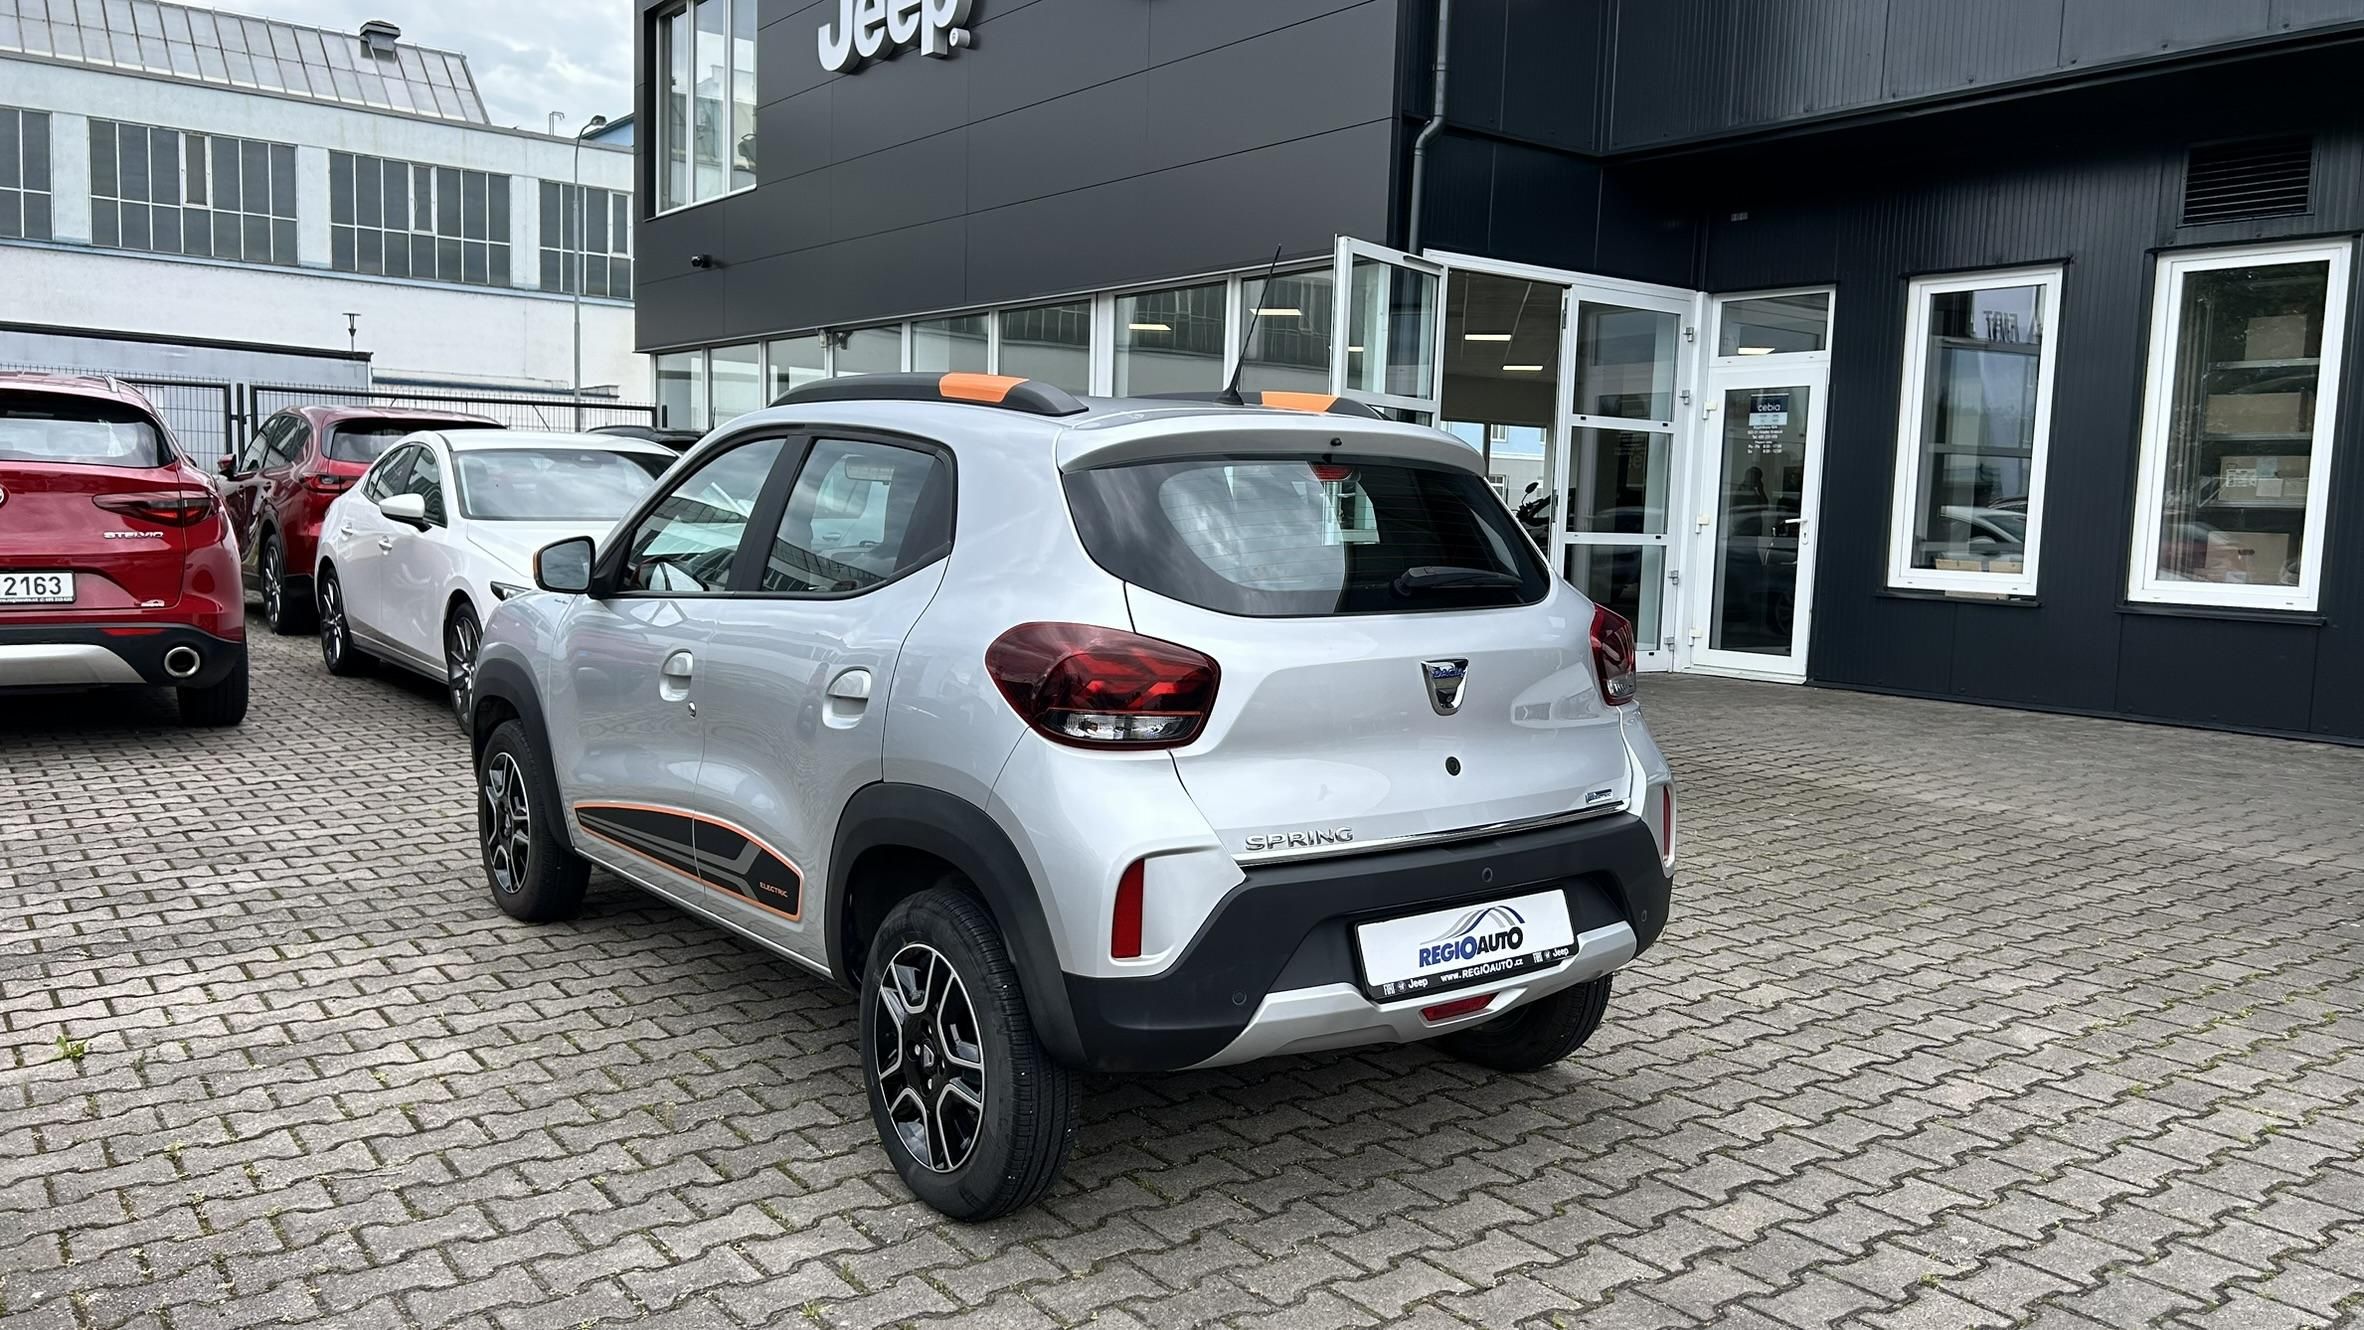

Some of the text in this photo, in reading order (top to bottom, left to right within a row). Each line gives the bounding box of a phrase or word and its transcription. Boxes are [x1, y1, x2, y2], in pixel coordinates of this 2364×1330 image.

[103, 531, 164, 539] STELVIO
[3, 576, 62, 596] 2163
[1245, 827, 1353, 850] SPRING
[759, 881, 788, 898] ELECTRIC
[1418, 926, 1523, 967] REGIOAUTO
[1407, 978, 1428, 989] Jeep
[1553, 947, 1569, 957] Jeep
